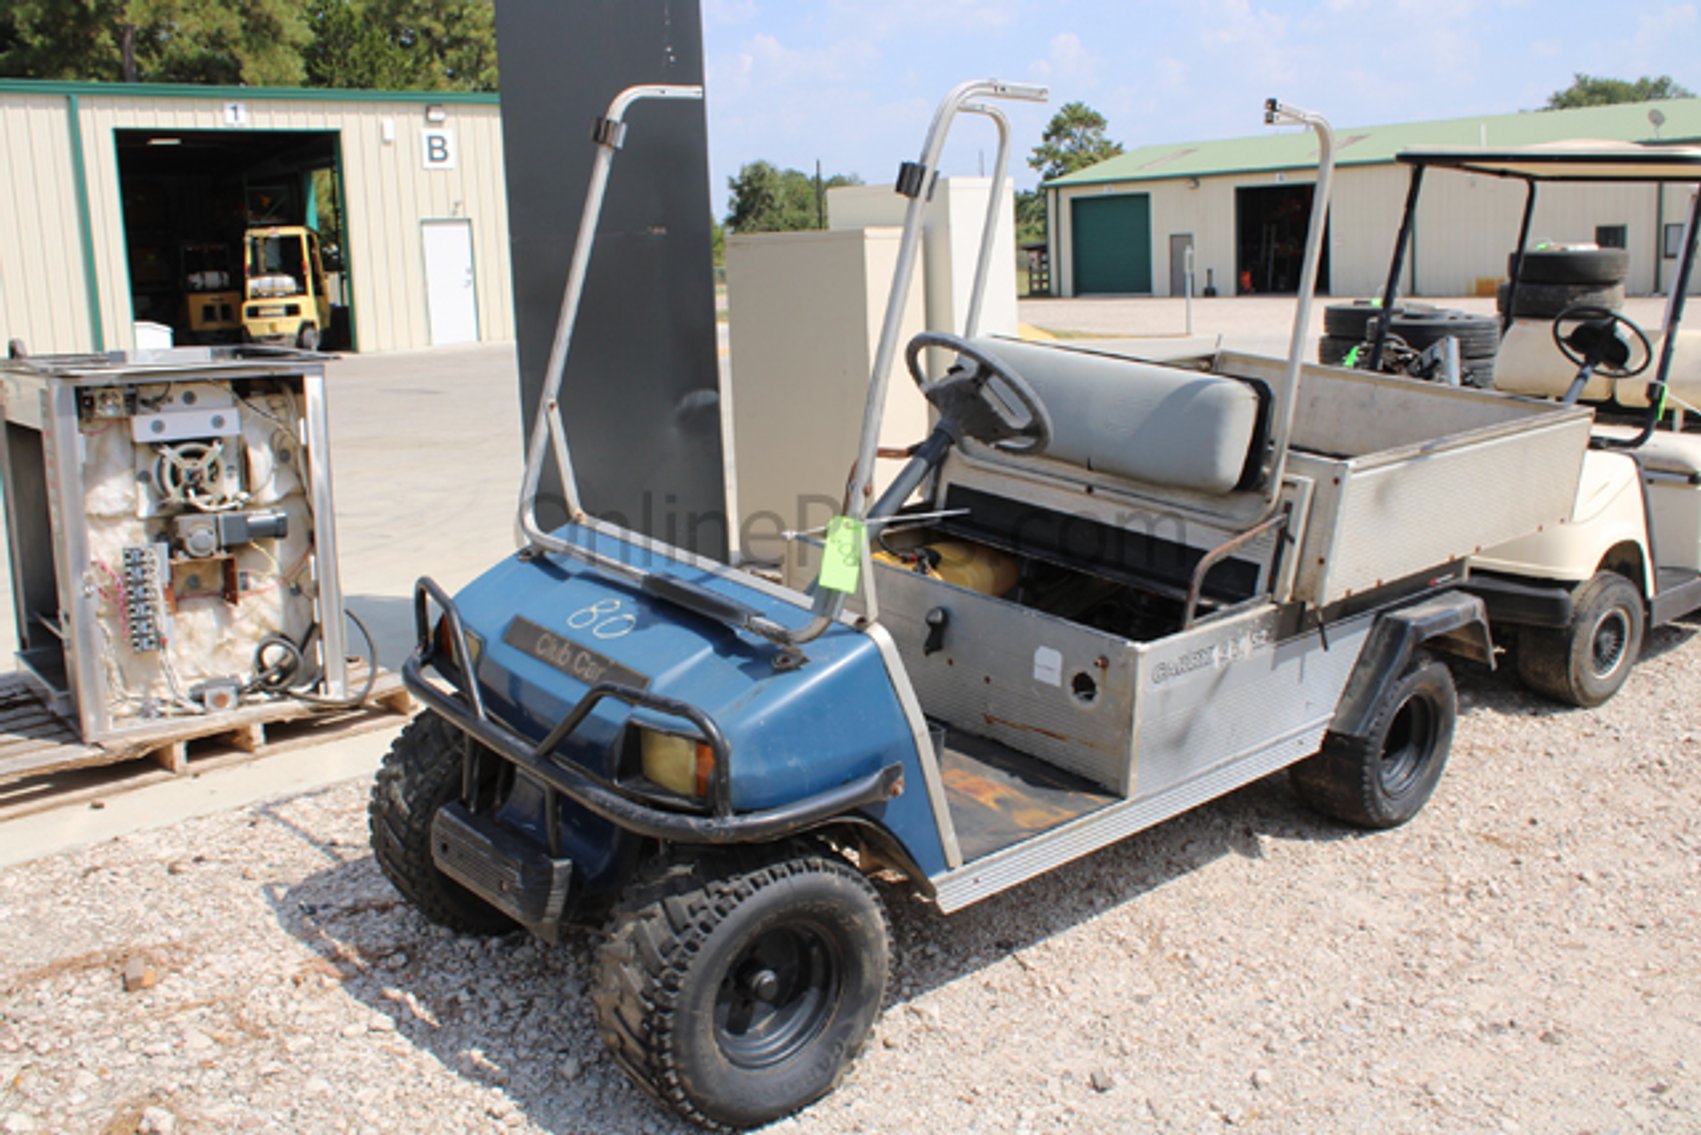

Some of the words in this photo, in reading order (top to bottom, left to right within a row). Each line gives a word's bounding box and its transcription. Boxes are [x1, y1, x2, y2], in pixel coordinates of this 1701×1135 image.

[231, 105, 239, 121] 1
[427, 135, 449, 162] B
[566, 599, 637, 639] 80
[536, 632, 571, 666] Club
[574, 650, 606, 681] Car
